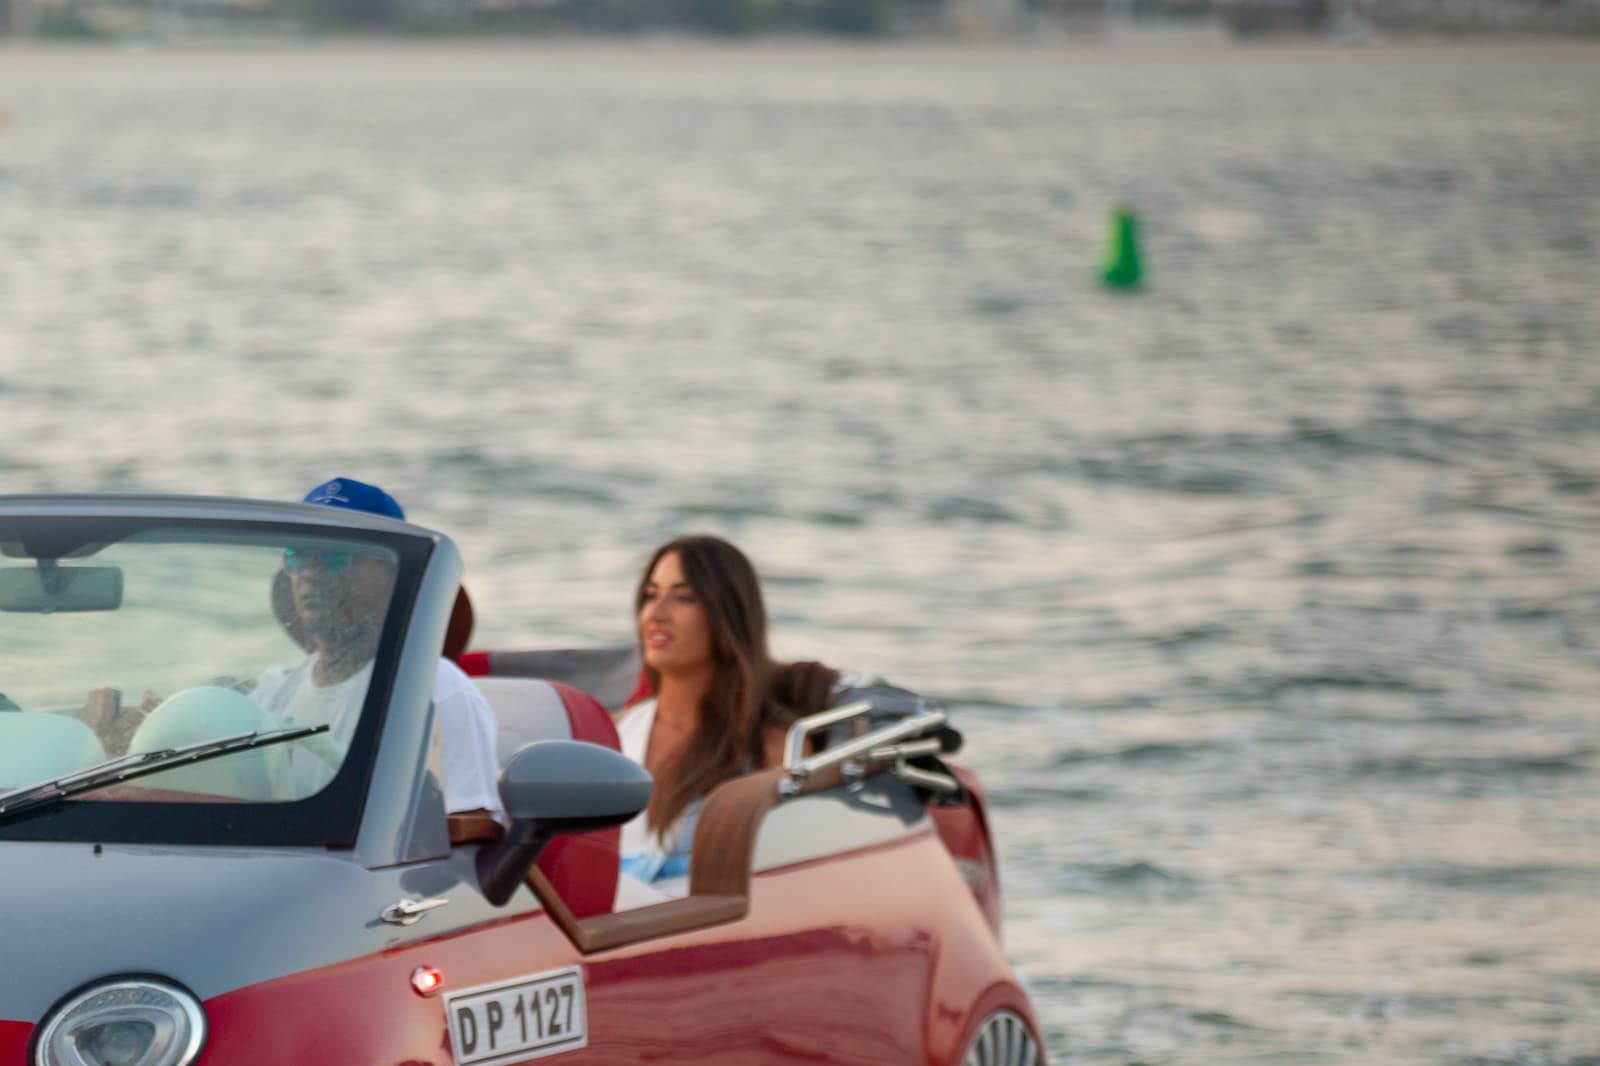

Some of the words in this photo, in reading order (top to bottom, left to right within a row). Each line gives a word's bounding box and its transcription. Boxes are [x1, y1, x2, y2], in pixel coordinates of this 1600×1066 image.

[457, 1006, 477, 1055] D
[485, 1000, 504, 1050] P
[514, 984, 574, 1043] 1127
